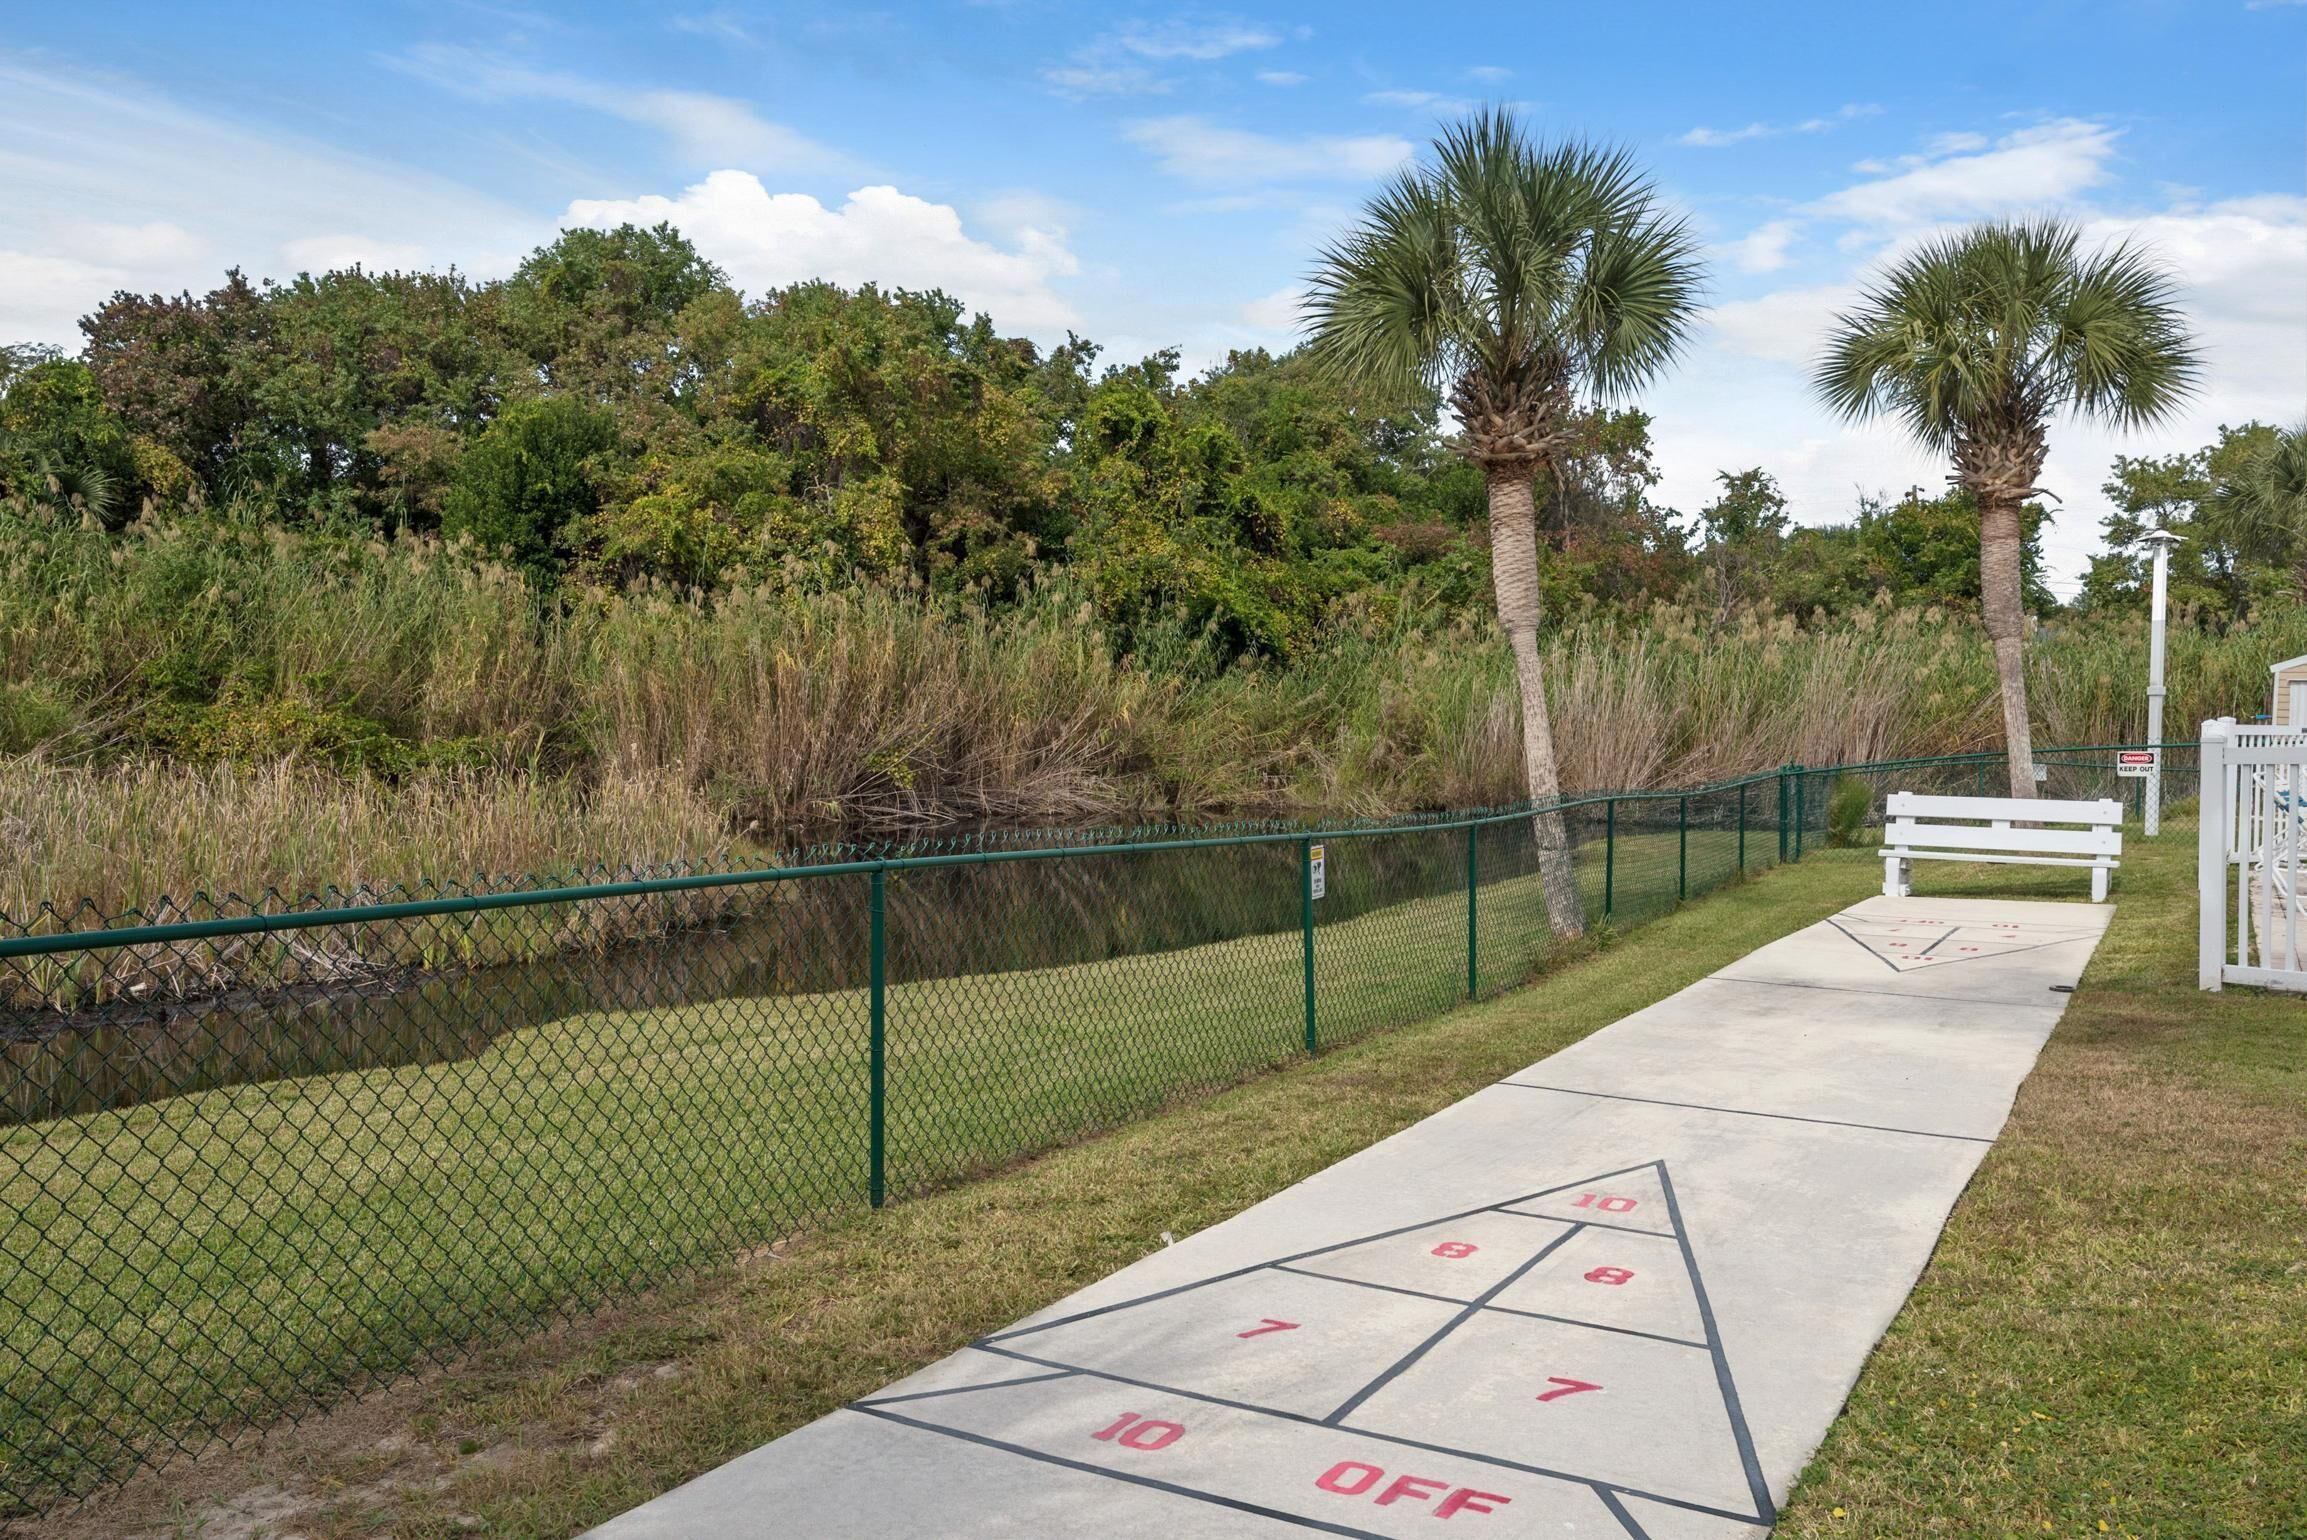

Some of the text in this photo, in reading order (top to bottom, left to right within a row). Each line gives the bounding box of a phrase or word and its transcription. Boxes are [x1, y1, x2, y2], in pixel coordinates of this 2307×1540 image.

[1572, 1193, 1638, 1213] 10
[1430, 1241, 1480, 1259] 8
[1583, 1266, 1635, 1287] 8
[1237, 1318, 1301, 1340] 7
[1535, 1376, 1604, 1402] 7
[1091, 1412, 1512, 1519] 10 OFF
